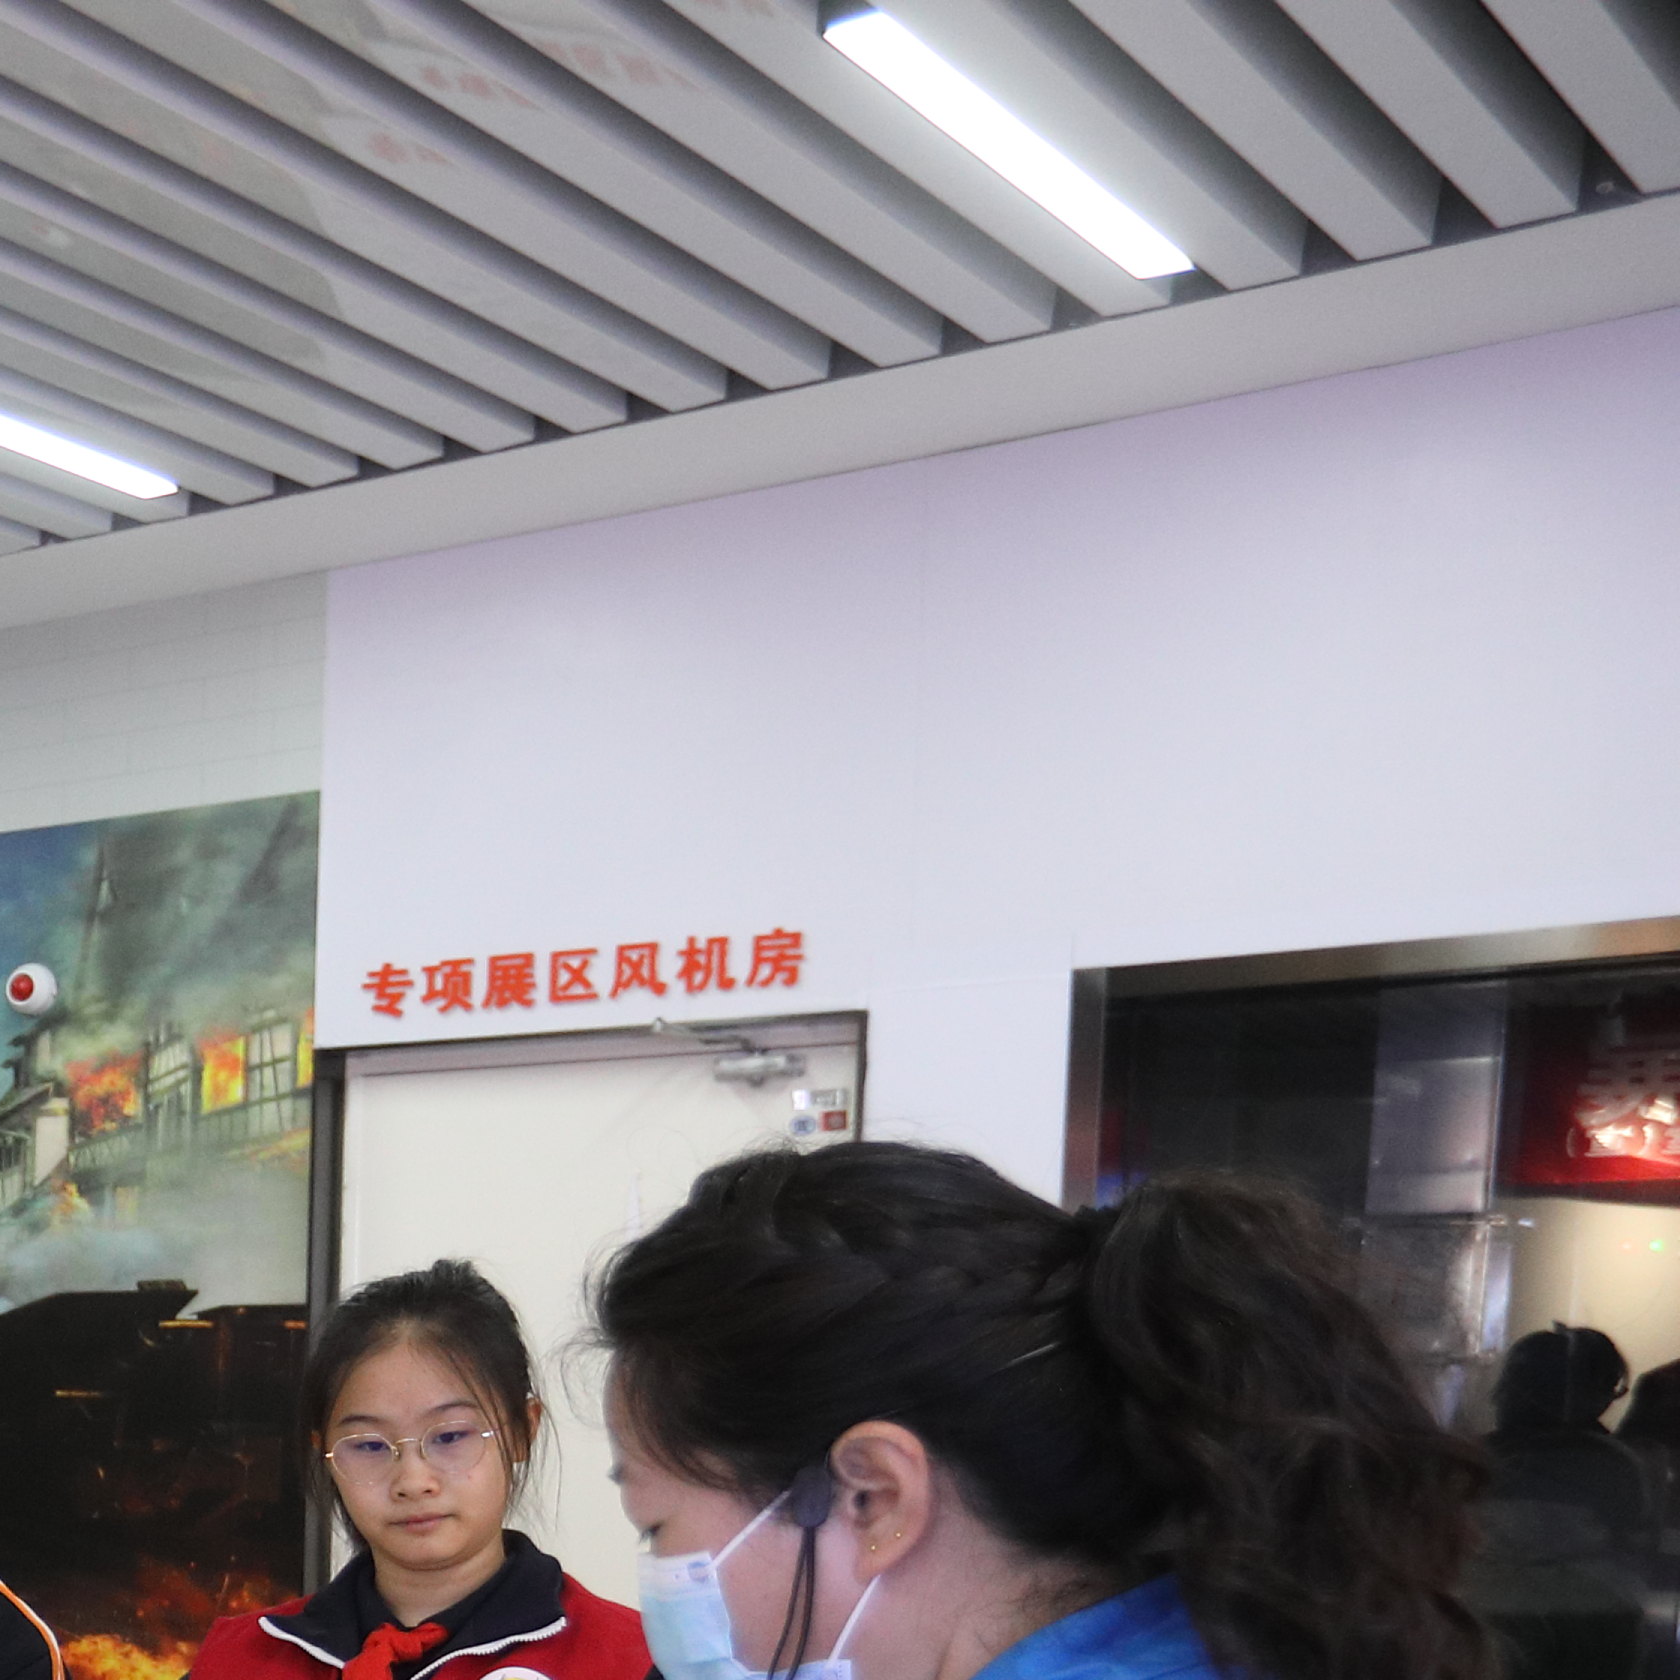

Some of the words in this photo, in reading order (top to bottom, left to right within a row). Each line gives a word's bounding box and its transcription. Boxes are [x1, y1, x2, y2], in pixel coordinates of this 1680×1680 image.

[362, 928, 805, 1018] 专项展区风机房
